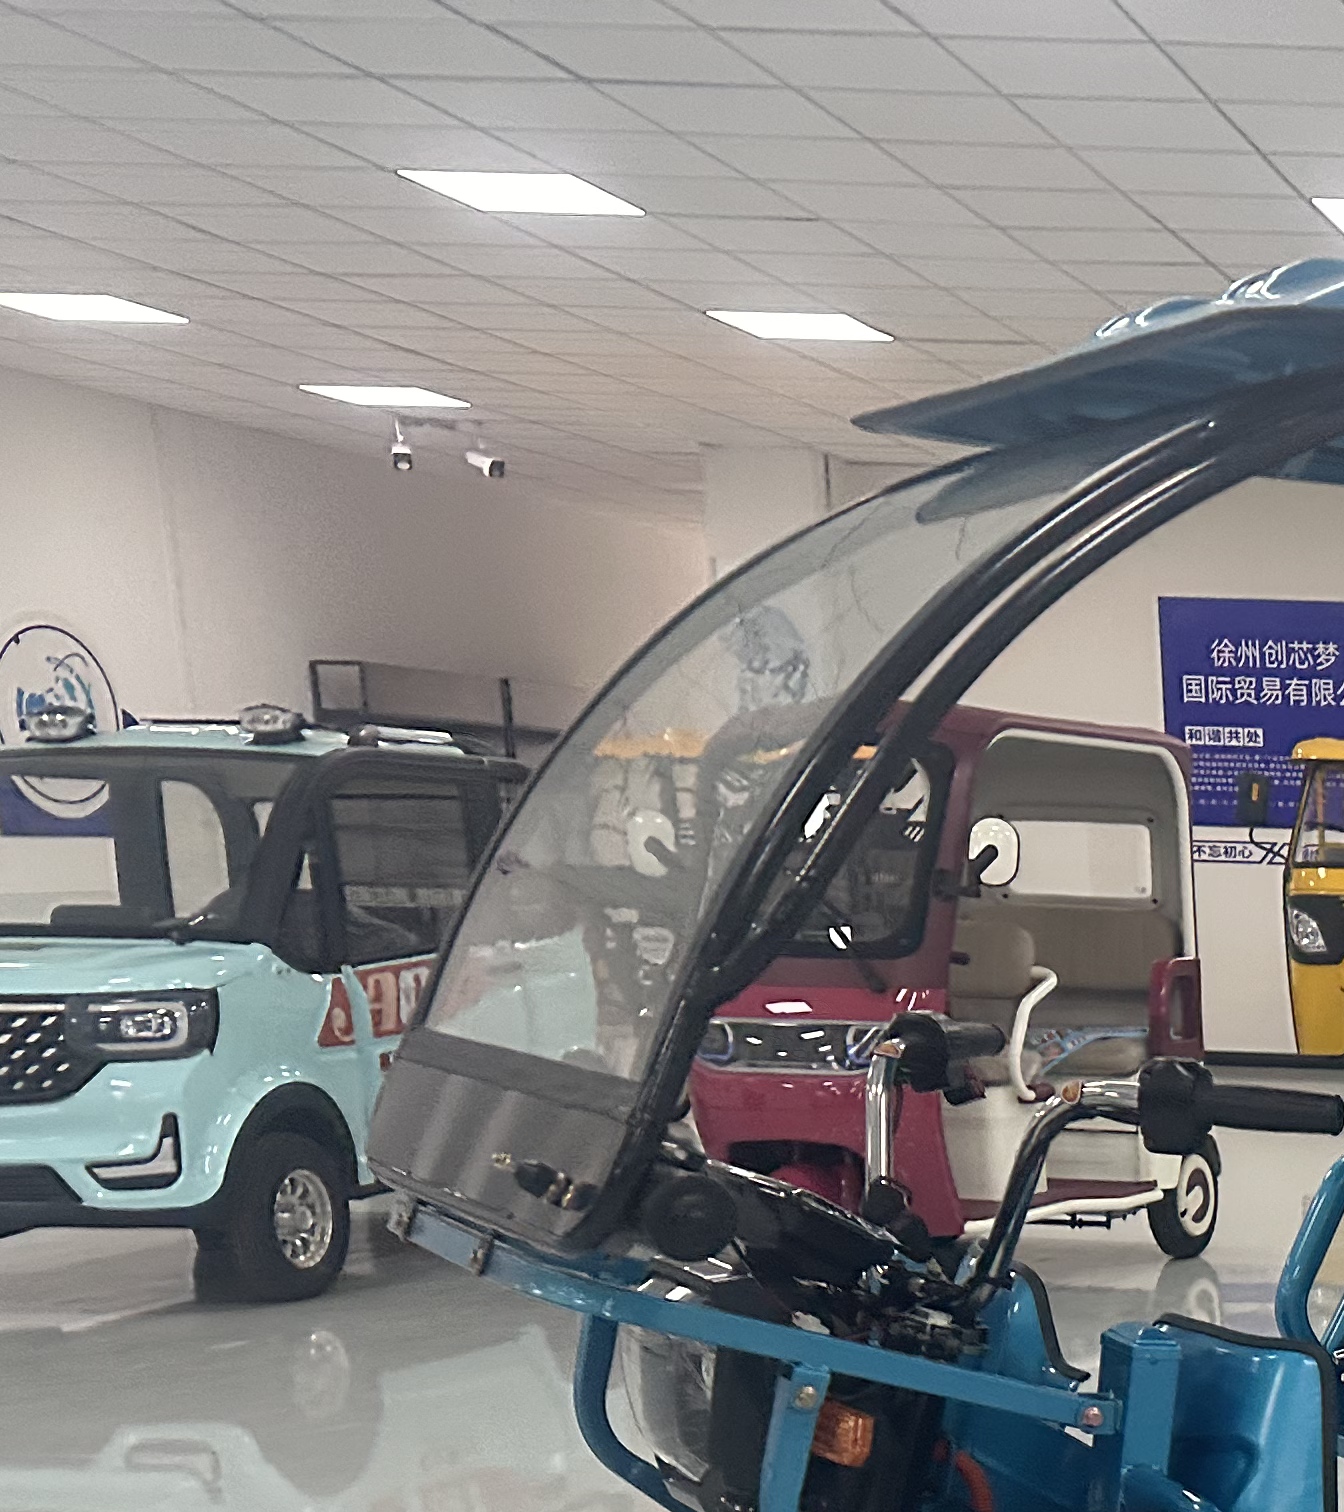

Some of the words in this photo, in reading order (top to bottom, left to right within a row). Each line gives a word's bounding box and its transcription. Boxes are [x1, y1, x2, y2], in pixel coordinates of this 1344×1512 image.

[1210, 638, 1340, 670] 徐州创芯梦
[1187, 727, 1262, 746] 和谐共处
[1192, 844, 1254, 859] 不忘初心
